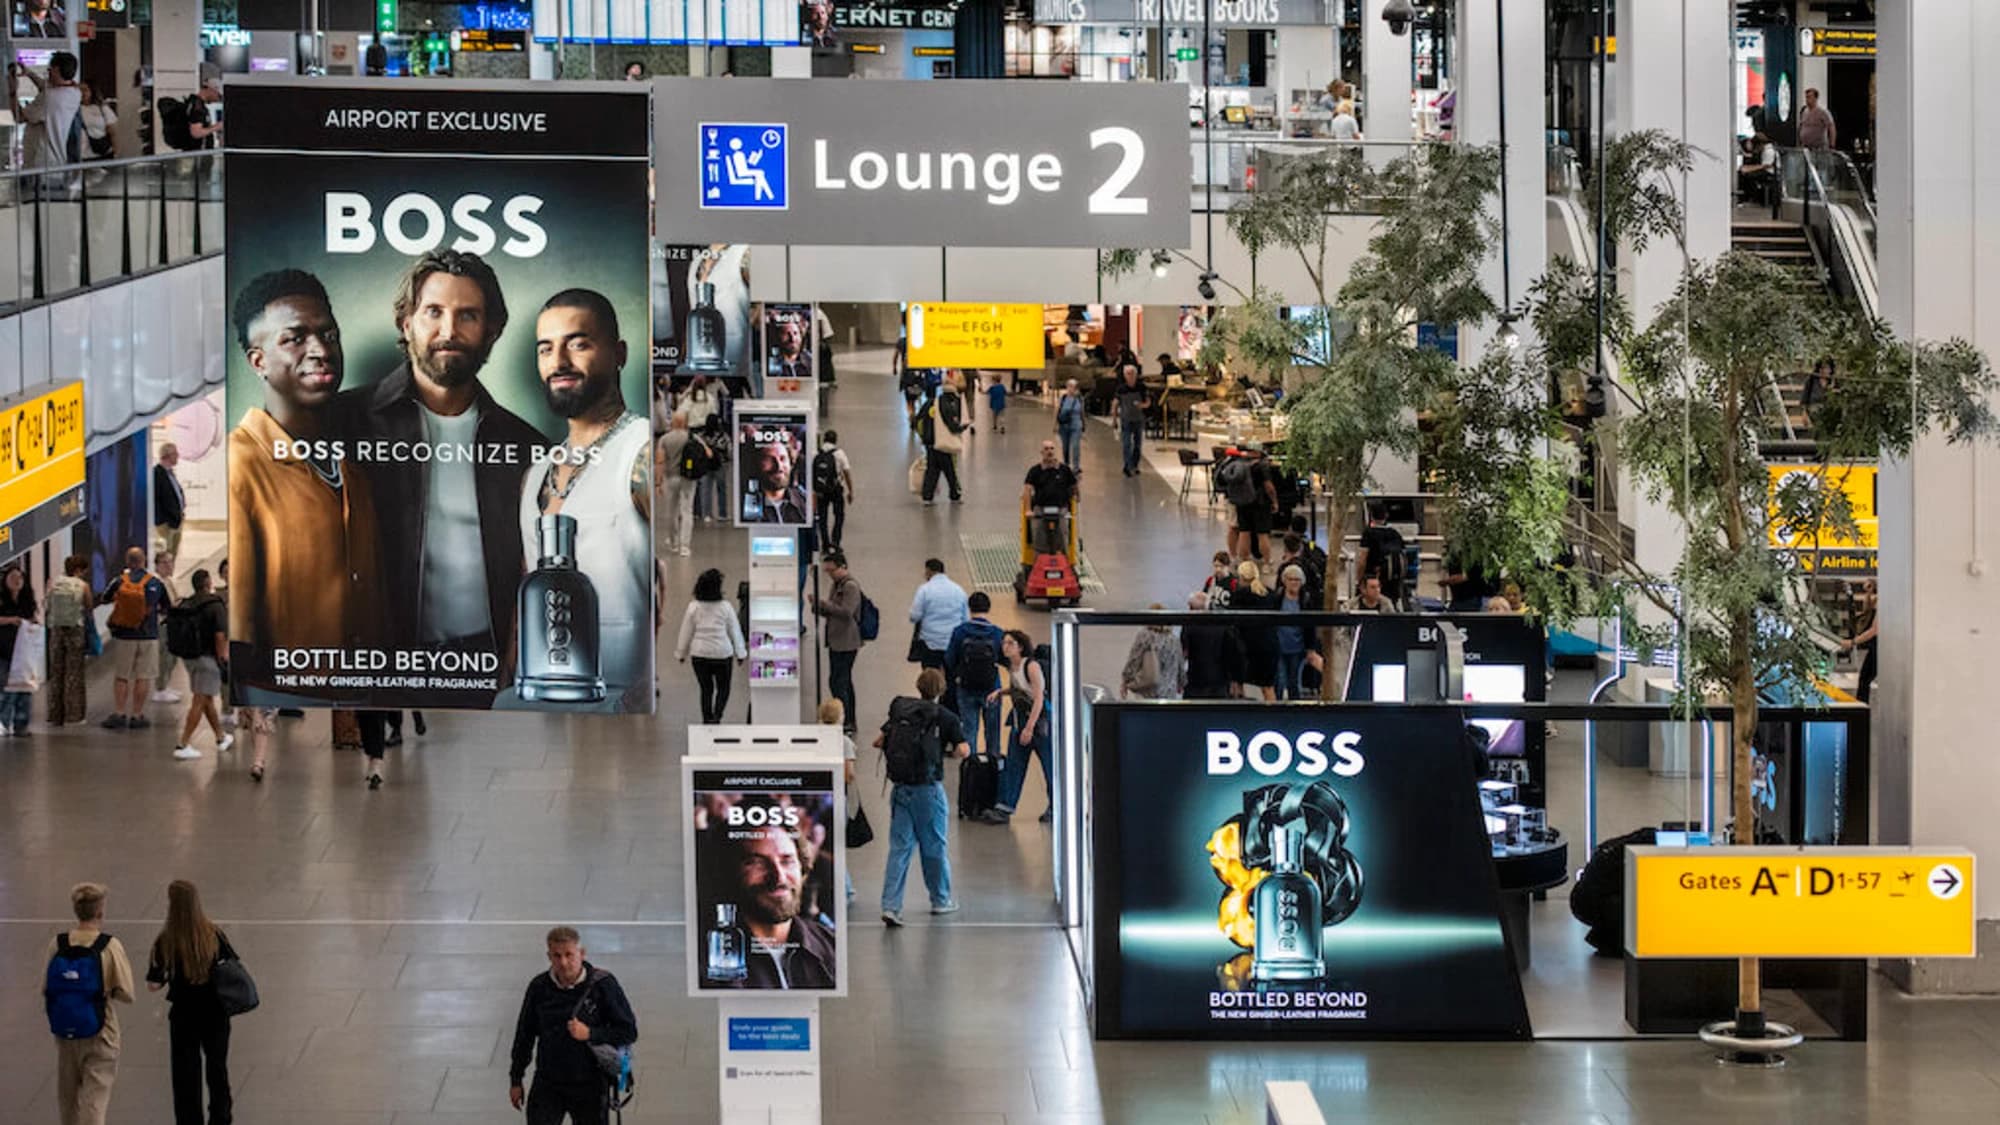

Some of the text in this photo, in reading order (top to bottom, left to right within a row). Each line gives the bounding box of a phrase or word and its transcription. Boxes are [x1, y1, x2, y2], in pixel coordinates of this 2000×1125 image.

[921, 10, 955, 27] CEN
[1213, 0, 1280, 22] BOOKS
[325, 110, 547, 132] AIRPORT EXCLUSIVE
[814, 126, 1149, 215] Lounge 2
[325, 192, 548, 258] BOSS
[273, 439, 602, 466] BOSS RECOGNIZE BOSS
[1821, 556, 1866, 569] Airline
[545, 589, 572, 666] BOSS
[274, 649, 499, 672] BOTTLED BEYOND
[275, 675, 497, 690] THE NEW GINGER-LEATHER FRAGRANCE
[1206, 730, 1366, 777] BOSS
[728, 806, 799, 827] BOSS
[1679, 872, 1742, 890] Gates
[1209, 992, 1368, 1008] BOTTLED BEYOND
